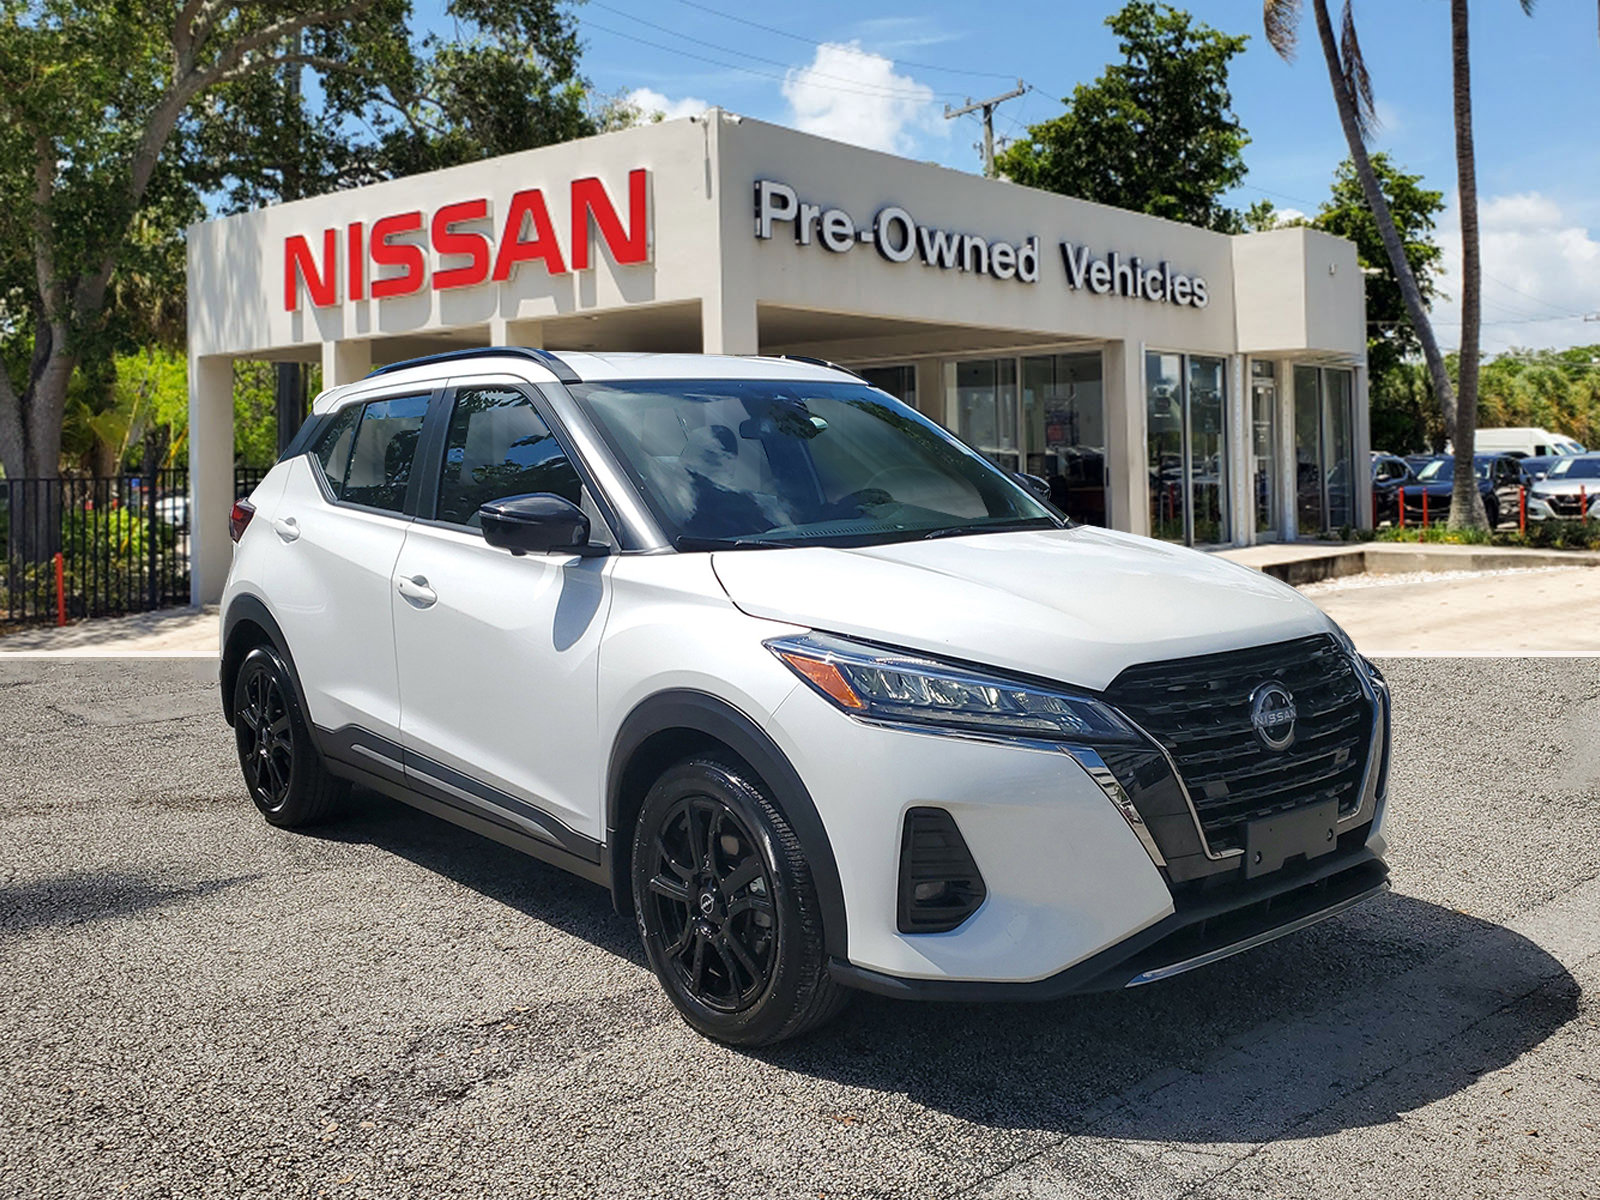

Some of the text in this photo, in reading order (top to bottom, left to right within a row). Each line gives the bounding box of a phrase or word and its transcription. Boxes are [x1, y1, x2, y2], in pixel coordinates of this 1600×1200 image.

[284, 168, 648, 312] NISSAN
[754, 180, 1209, 308] Pre-Owned Vehicles
[1254, 709, 1297, 727] NISSAN
